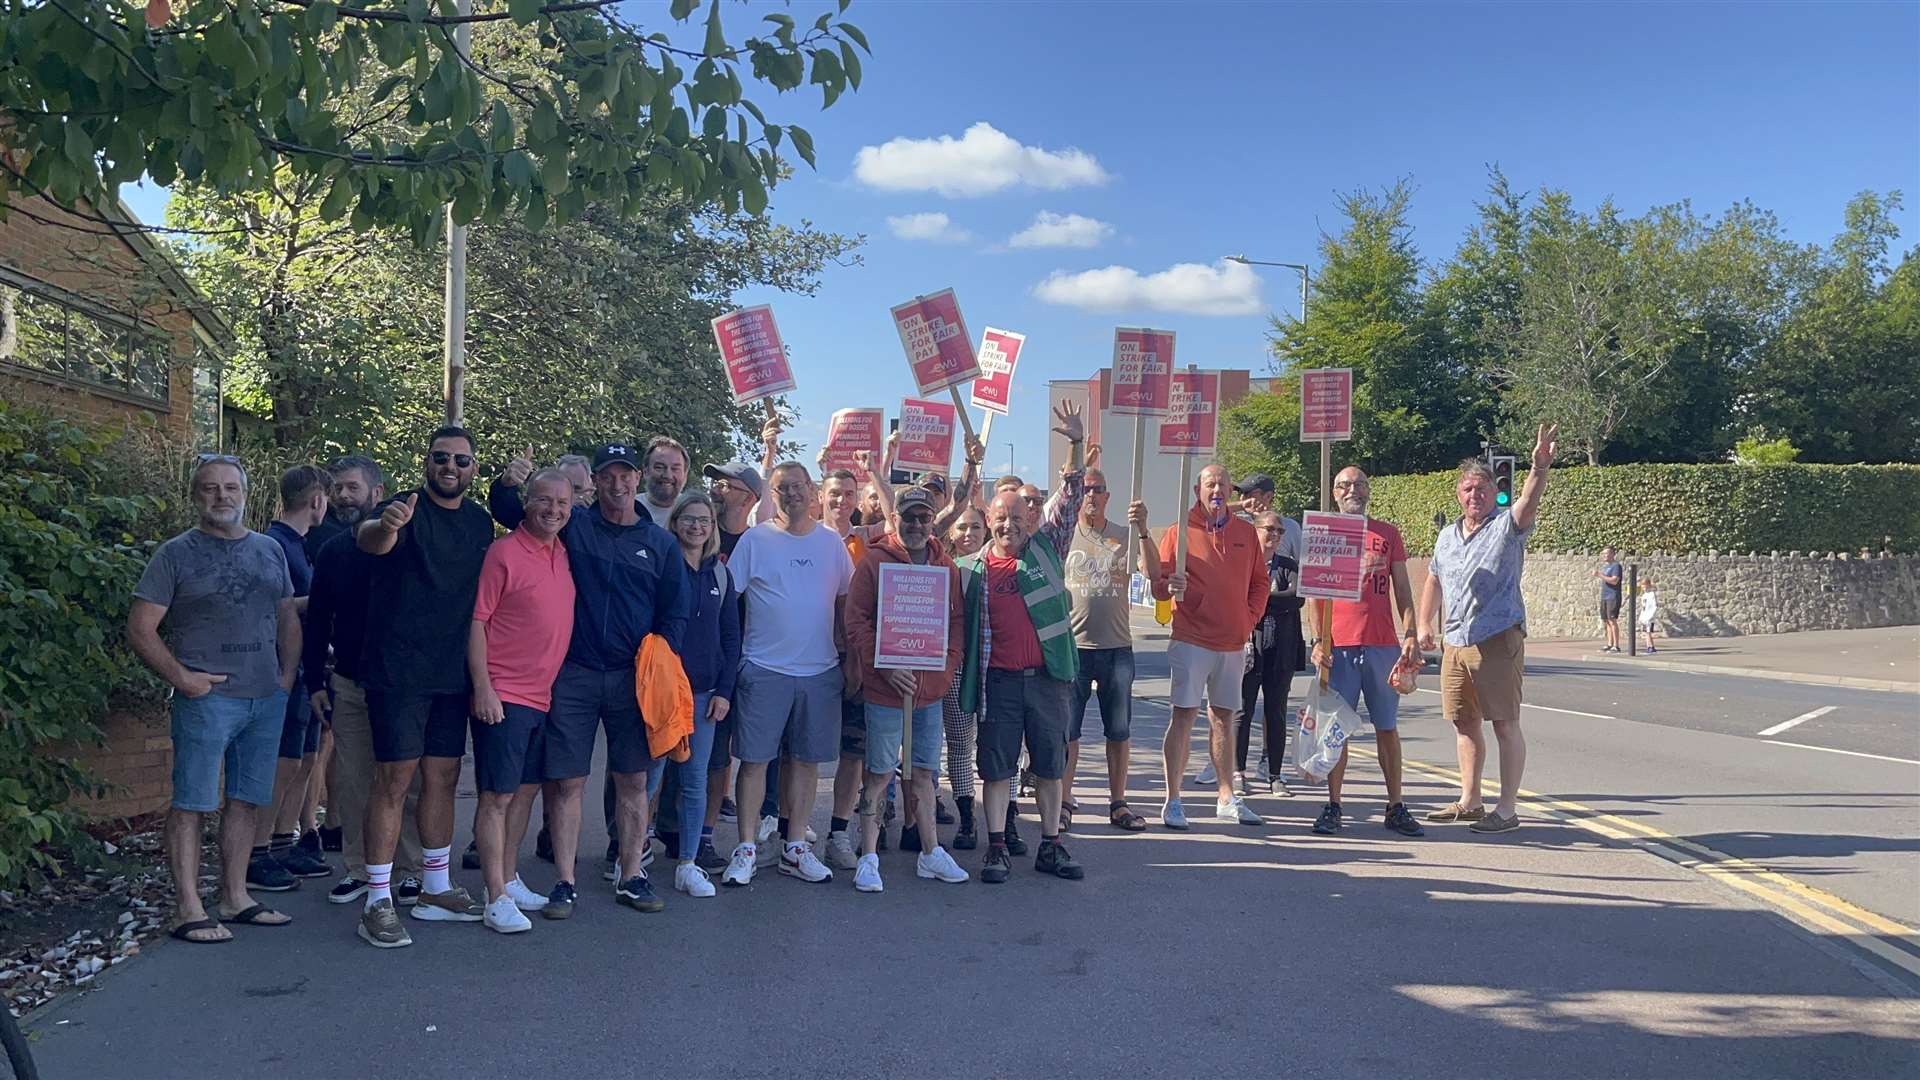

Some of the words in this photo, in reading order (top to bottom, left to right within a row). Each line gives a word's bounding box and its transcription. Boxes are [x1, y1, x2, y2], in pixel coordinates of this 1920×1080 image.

[903, 317, 918, 330] ON
[907, 320, 941, 340] STRIKE
[911, 336, 930, 351] FOR
[933, 326, 957, 342] FAIR
[985, 342, 996, 350] ON
[1121, 343, 1135, 351] ON
[916, 345, 934, 360] PAY
[983, 351, 1005, 361] STRIKE
[1120, 353, 1152, 362] STRIKE
[981, 361, 993, 369] FOR
[993, 362, 1008, 371] FAIR
[1120, 364, 1139, 372] FOR
[1141, 364, 1163, 373] FAIR
[1120, 374, 1138, 382] PAY
[1172, 384, 1181, 392] N
[1171, 393, 1197, 402] TRIKE
[906, 406, 920, 414] ON
[1187, 403, 1209, 412] FAIR
[905, 415, 935, 423] STRIKE
[904, 424, 924, 432] FOR
[925, 424, 945, 433] FAIR
[904, 432, 921, 440] PAY
[1308, 536, 1342, 545] STRIKE
[1308, 546, 1327, 554] FOR
[1330, 546, 1352, 555] FAIR
[1308, 555, 1326, 563] PAY
[893, 575, 923, 584] MILLIONS
[925, 577, 937, 585] FOR
[1090, 572, 1111, 588] 66
[897, 583, 909, 592] THE
[921, 597, 935, 605] FOR
[884, 616, 911, 624] SUPPORT
